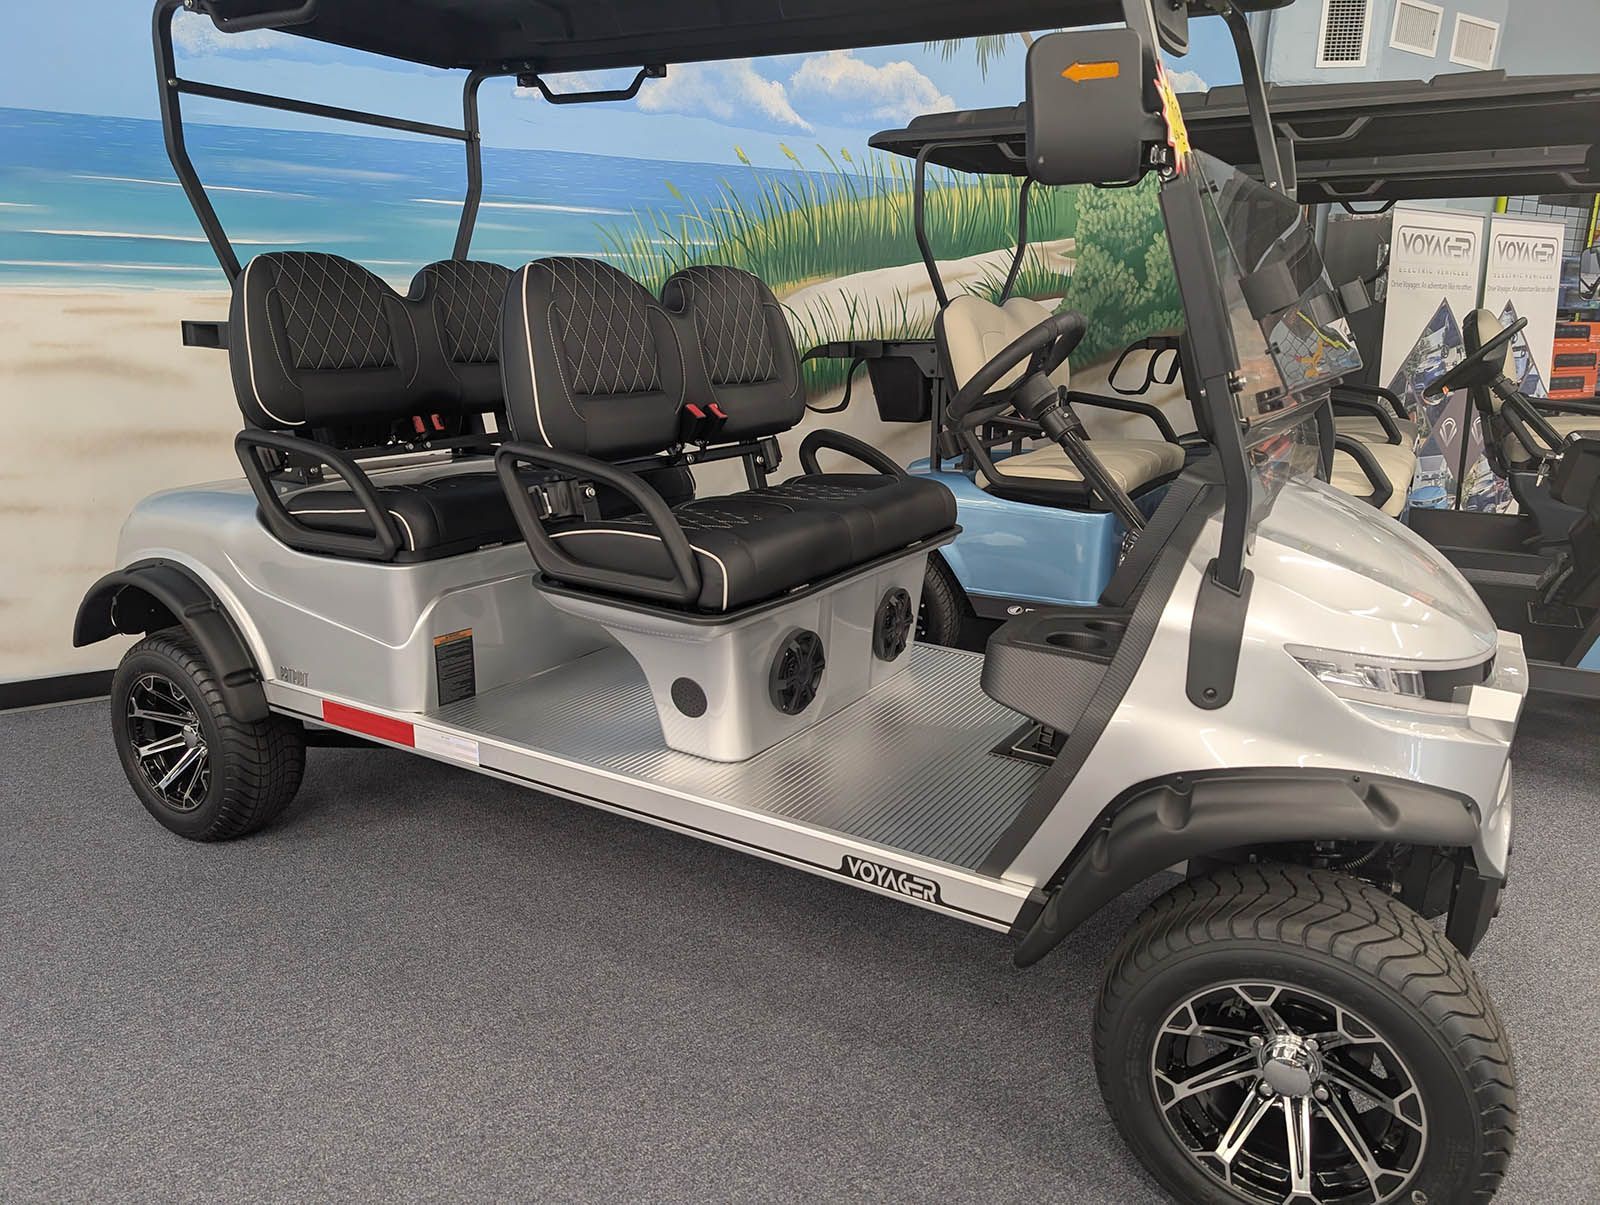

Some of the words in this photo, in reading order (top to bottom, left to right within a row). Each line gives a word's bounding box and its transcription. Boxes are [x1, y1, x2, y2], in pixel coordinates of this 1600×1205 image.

[1402, 232, 1472, 259] VOYAGER
[1498, 240, 1555, 263] VOYAGER
[846, 856, 937, 903] VOYAGER
